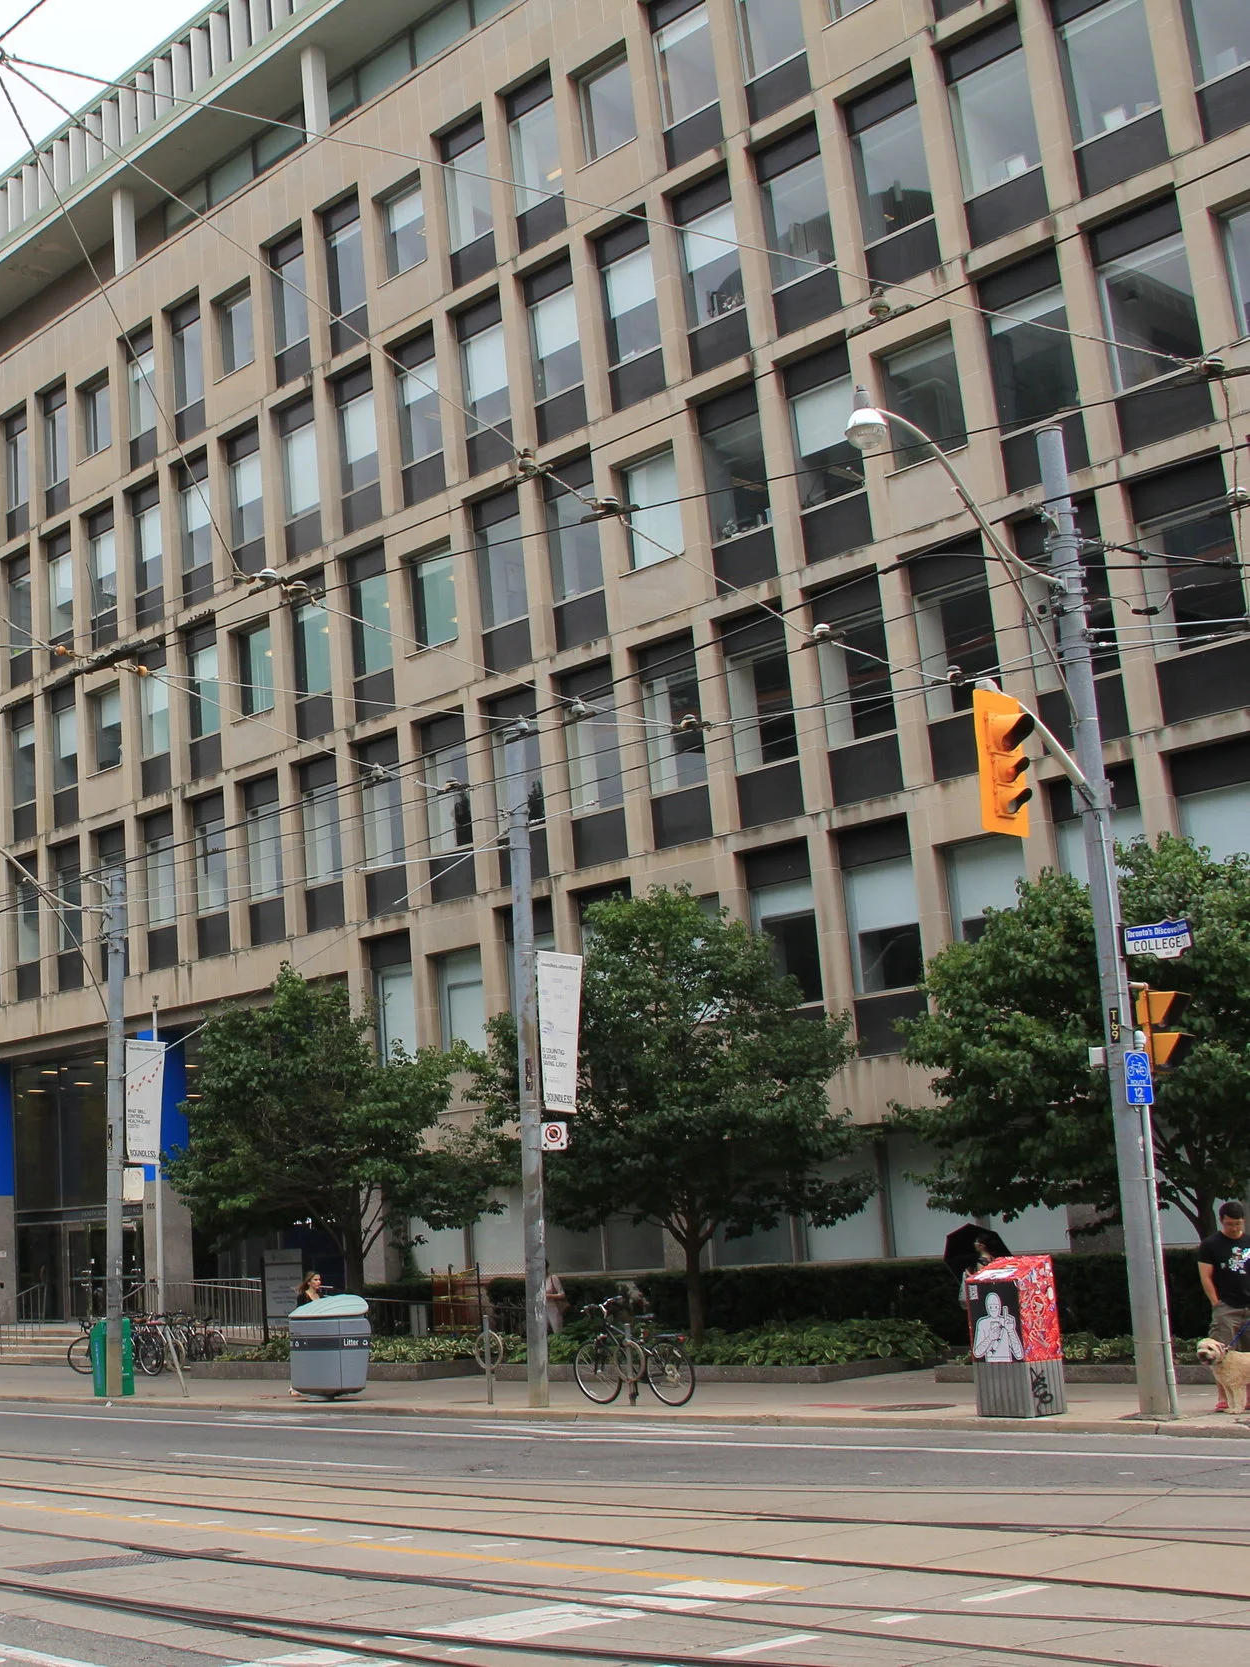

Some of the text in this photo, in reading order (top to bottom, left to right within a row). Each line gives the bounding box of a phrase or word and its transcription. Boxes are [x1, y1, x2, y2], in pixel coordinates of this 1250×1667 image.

[1126, 928, 1153, 938] Toronto's
[1133, 936, 1182, 952] COLLEGE
[1134, 1087, 1144, 1098] 12
[546, 1092, 573, 1104] BOUNDLESS
[129, 1149, 157, 1158] BOUNDLESS
[343, 1338, 359, 1347] Litter
